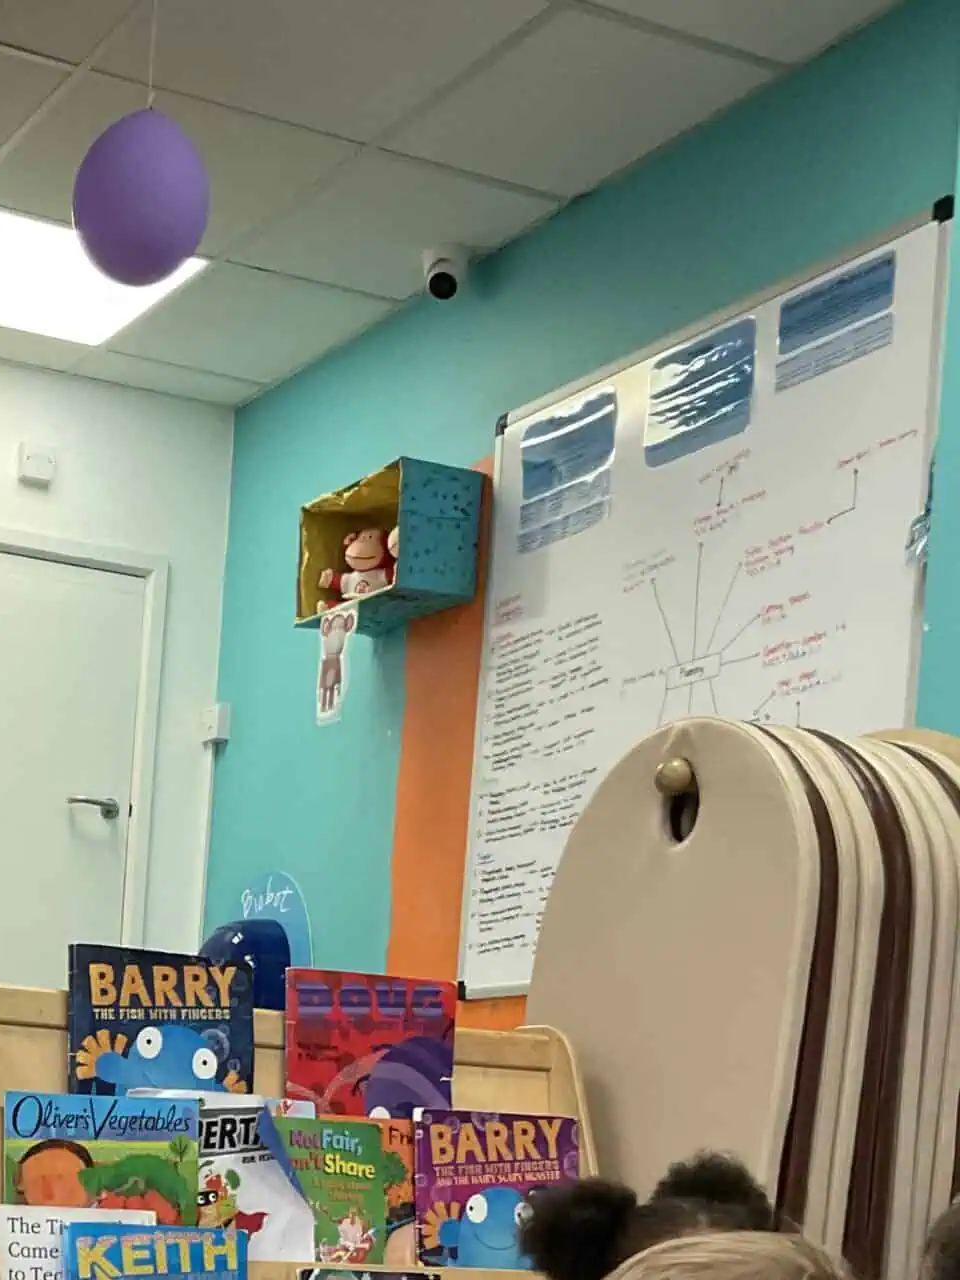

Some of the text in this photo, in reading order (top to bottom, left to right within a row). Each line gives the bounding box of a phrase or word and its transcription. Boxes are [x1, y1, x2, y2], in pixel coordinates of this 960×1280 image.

[89, 963, 237, 1007] BARRY
[93, 1008, 231, 1020] THE FISH WITH FINGERS
[12, 1095, 192, 1140] Oliver's Vegetables
[322, 1127, 363, 1156] Fair,
[429, 1119, 563, 1164] BARRY
[324, 1152, 376, 1179] Share
[433, 1165, 454, 1177] THE
[514, 1159, 560, 1173] FINGERS
[7, 1216, 41, 1235] The
[8, 1241, 59, 1260] Came
[75, 1229, 238, 1279] KEITH
